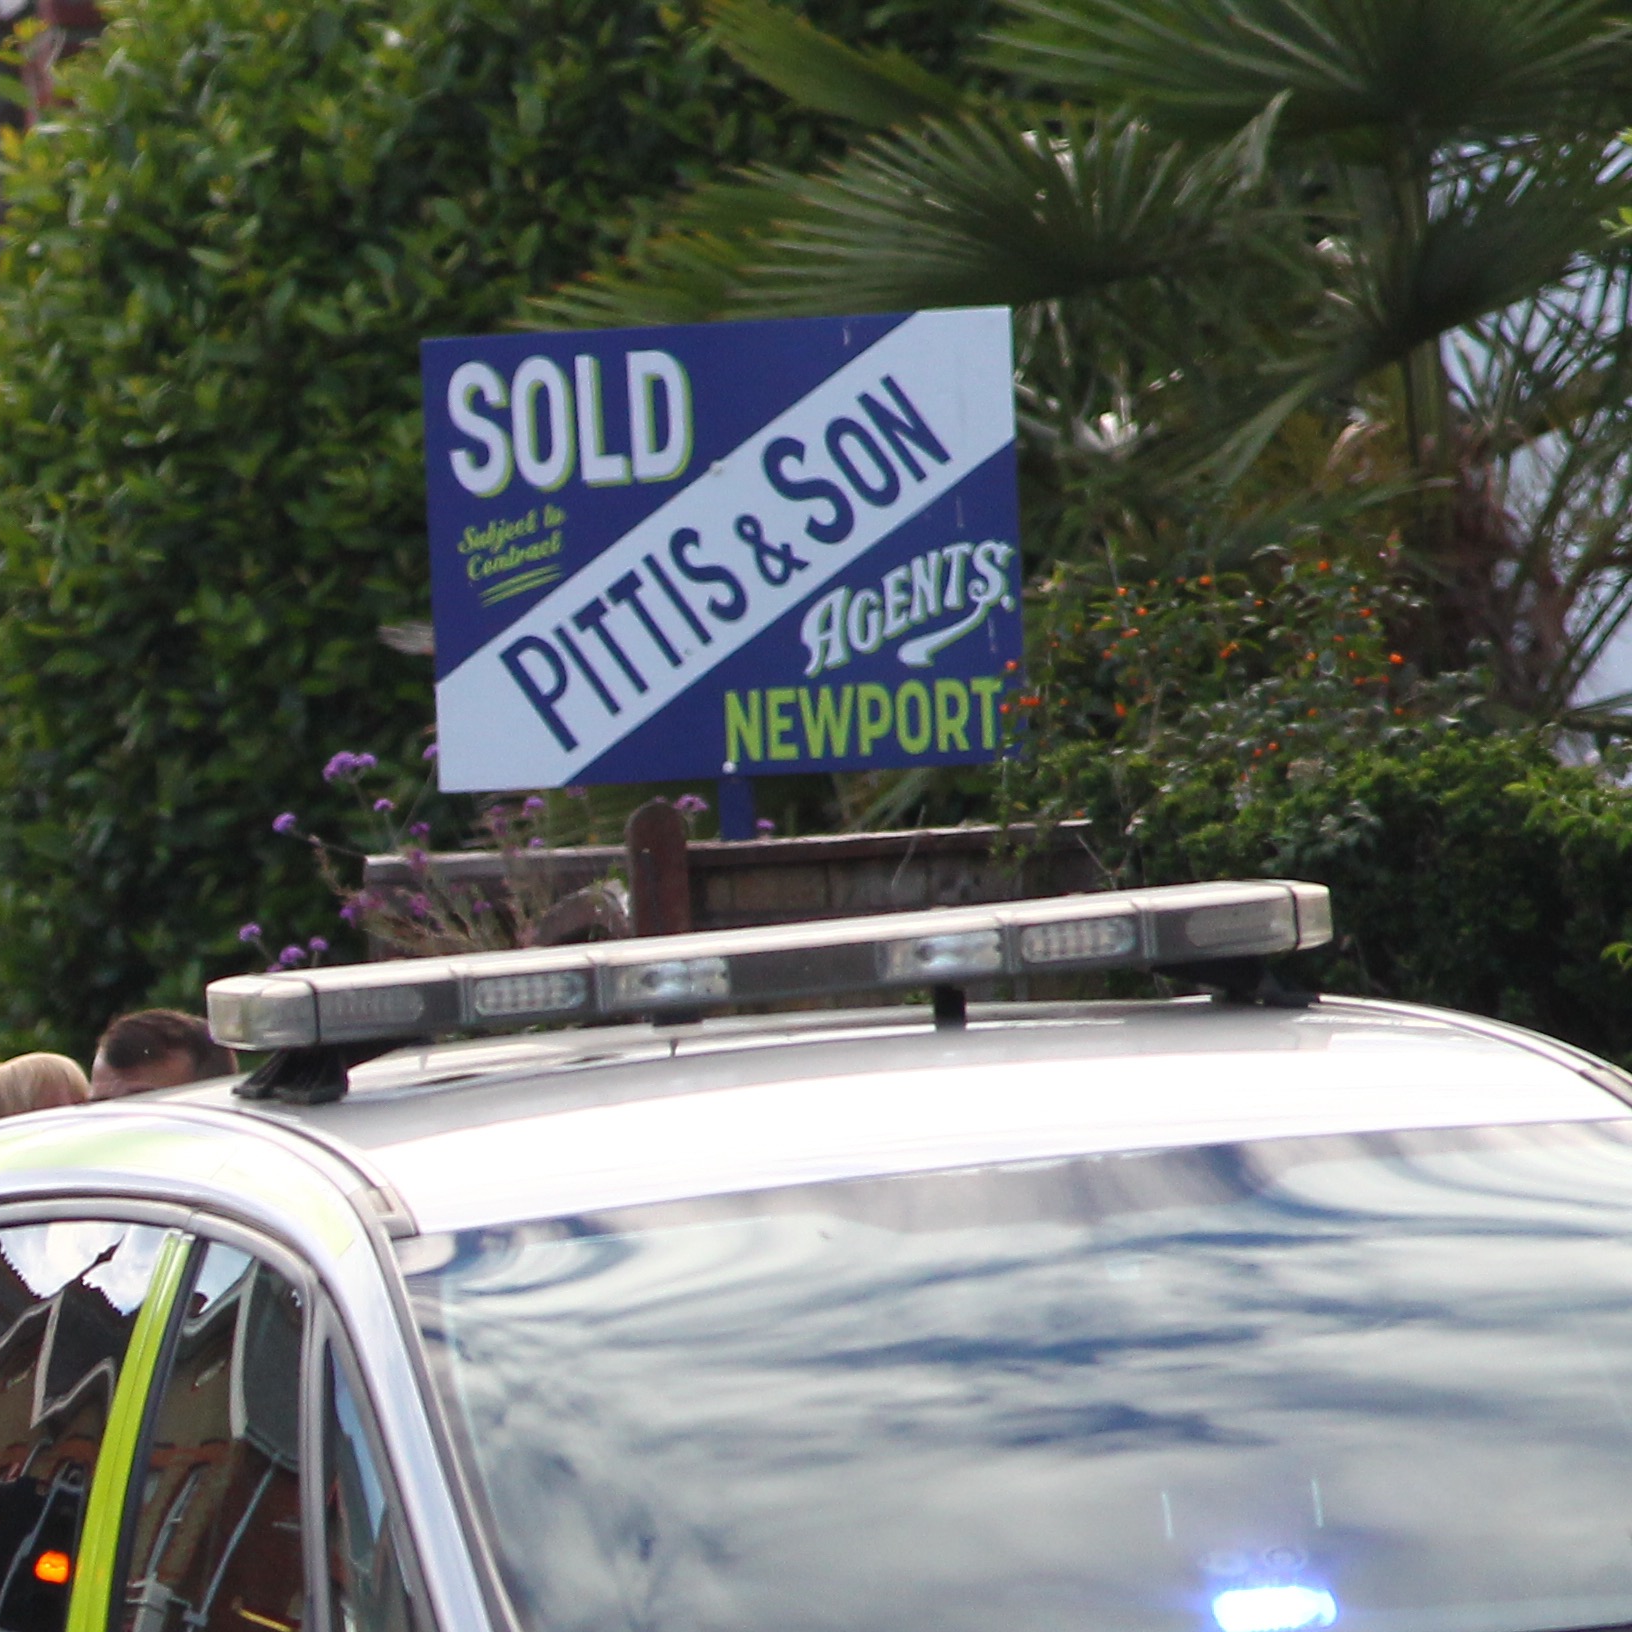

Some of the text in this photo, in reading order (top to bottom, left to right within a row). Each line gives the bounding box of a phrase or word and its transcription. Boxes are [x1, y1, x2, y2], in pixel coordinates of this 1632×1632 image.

[448, 348, 693, 497] SOLD
[499, 374, 953, 752] PITTIS & SON
[725, 676, 1004, 764] NEWPORT
